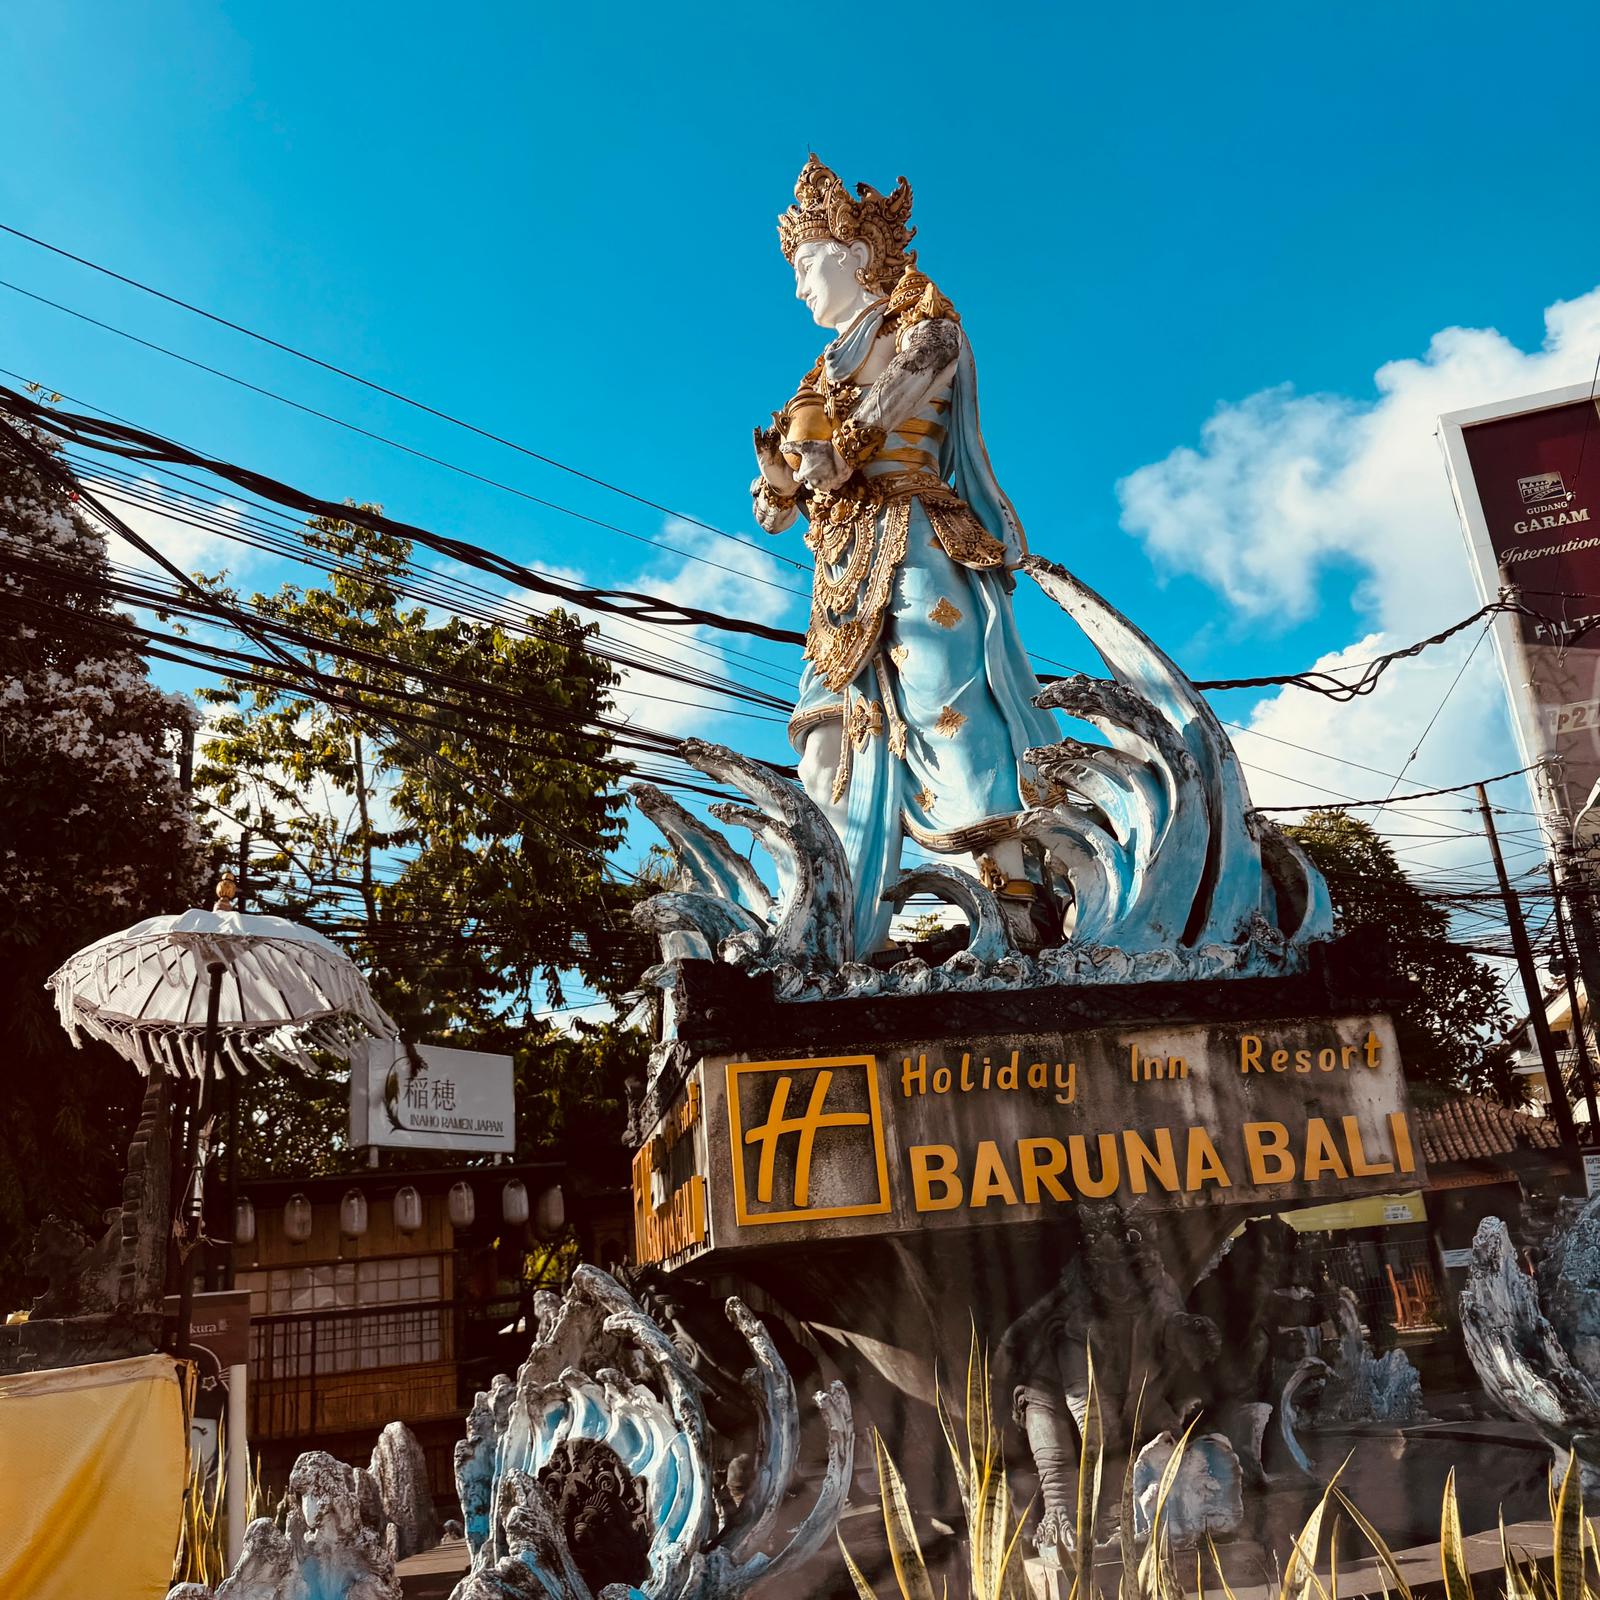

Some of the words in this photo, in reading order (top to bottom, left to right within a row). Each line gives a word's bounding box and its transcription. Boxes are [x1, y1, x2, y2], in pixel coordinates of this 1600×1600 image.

[1514, 508, 1591, 534] GARAM
[1526, 501, 1568, 515] GUDANG
[902, 1051, 1076, 1105] Holiday
[1130, 1043, 1188, 1082] Inn
[1241, 1031, 1382, 1073] Resort
[403, 1078, 456, 1111] 稲穂
[410, 1114, 439, 1128] INAHO
[441, 1116, 473, 1131] RAMEN
[475, 1119, 503, 1133] JAPAN
[909, 1126, 1232, 1212] BARUNA
[1243, 1111, 1415, 1184] BALI
[190, 1322, 217, 1334] kura
